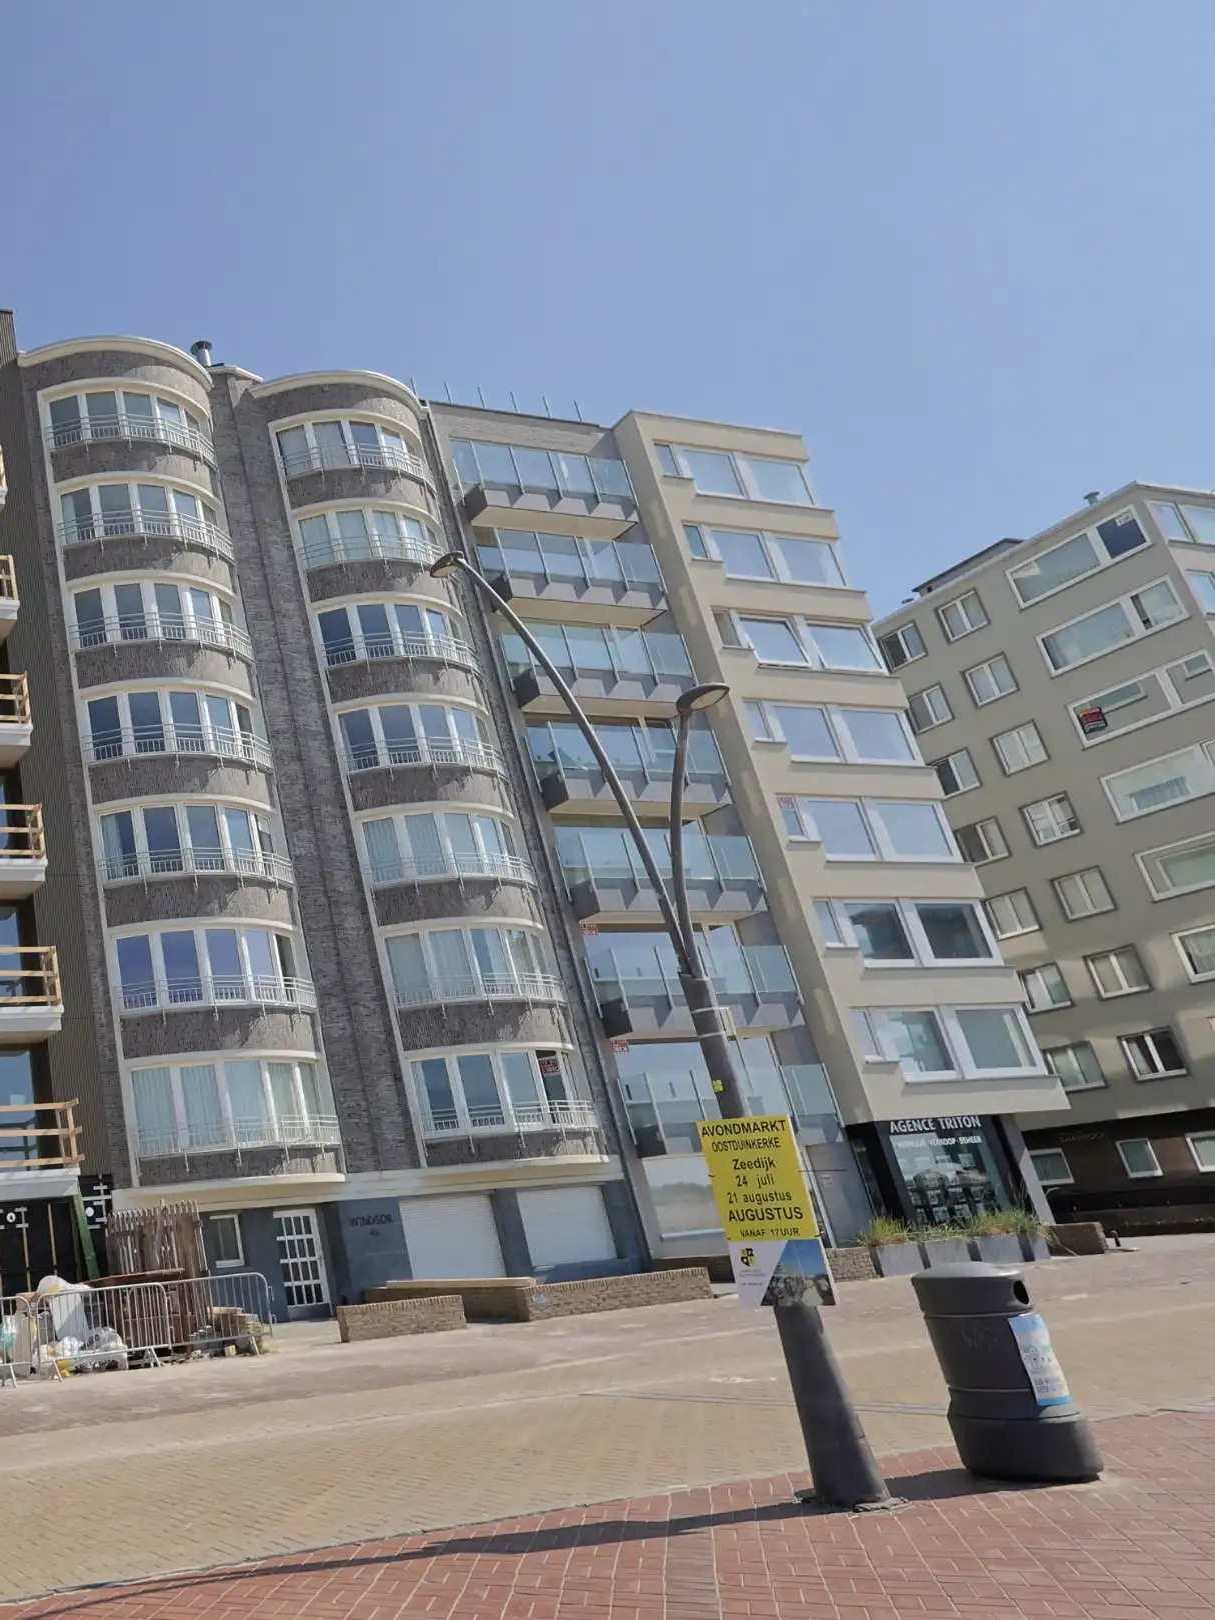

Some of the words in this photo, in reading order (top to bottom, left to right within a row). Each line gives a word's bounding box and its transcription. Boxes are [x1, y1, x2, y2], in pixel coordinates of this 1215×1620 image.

[702, 1120, 786, 1137] AVONDMARKT
[890, 1118, 936, 1133] AGENCE
[938, 1115, 981, 1129] TRITON
[712, 1137, 781, 1152] OOSTDUINKERKE
[929, 1137, 956, 1147] VERKOOP
[732, 1157, 776, 1171] Zeedijk
[736, 1175, 748, 1187] 24
[757, 1173, 775, 1189] juli
[727, 1192, 738, 1204] 21
[743, 1190, 792, 1205] augustus
[349, 1214, 393, 1227] WINDSOR
[728, 1206, 803, 1222] AUGUSTUS
[740, 1229, 766, 1237] VANAF
